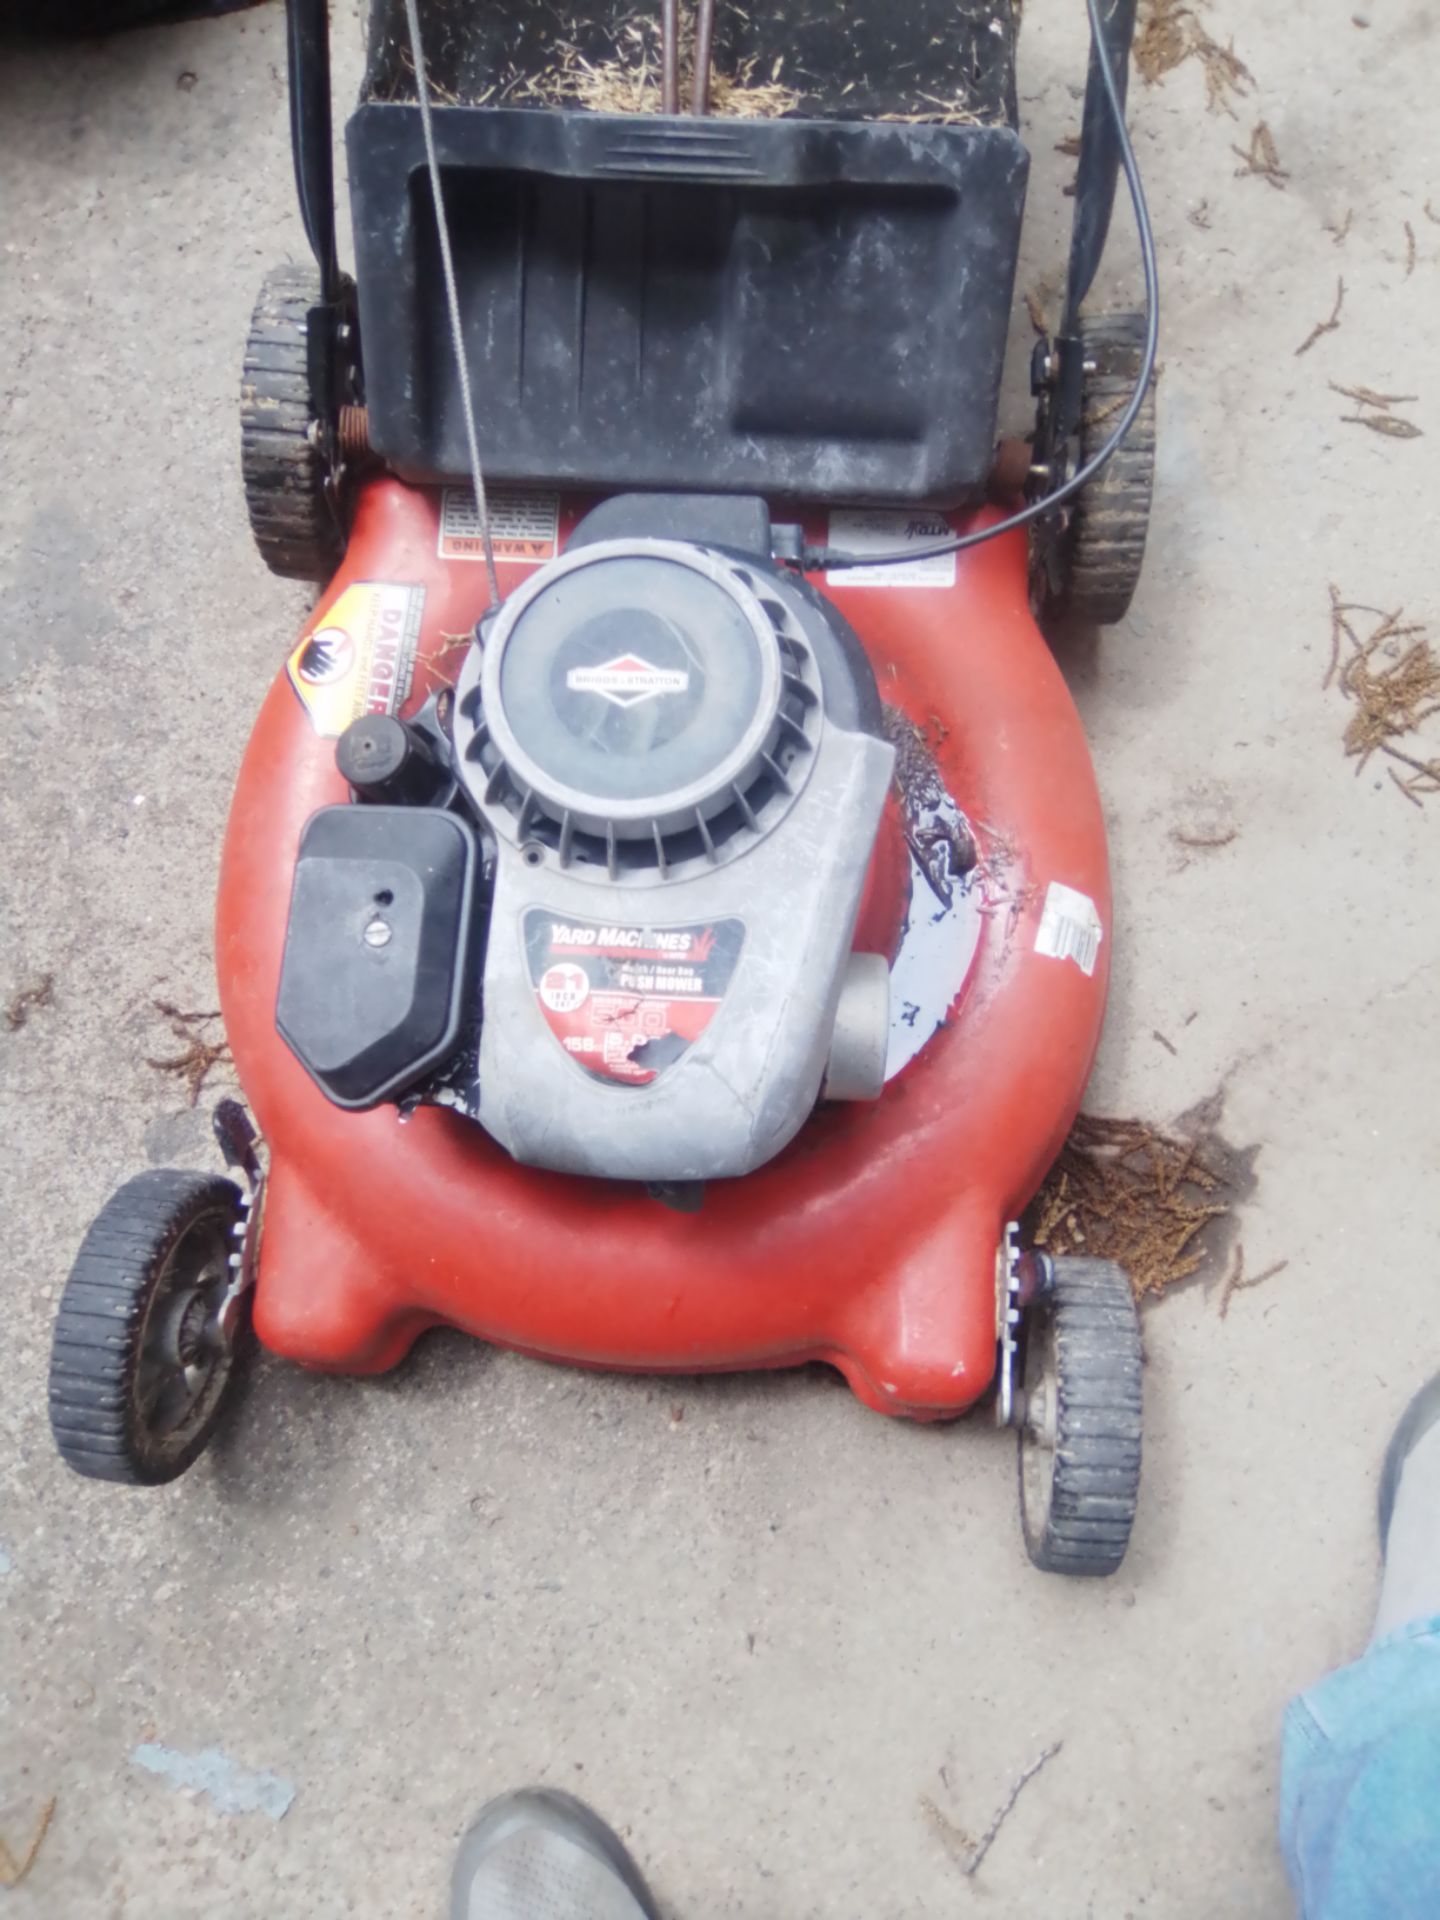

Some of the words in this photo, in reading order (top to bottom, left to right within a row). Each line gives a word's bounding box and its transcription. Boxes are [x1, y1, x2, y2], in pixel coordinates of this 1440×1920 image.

[452, 541, 526, 555] WARING
[366, 609, 402, 715] DANGER
[627, 675, 681, 686] STRATTON
[551, 925, 597, 946] YARD
[598, 927, 692, 950] MACNES
[545, 970, 584, 991] 21
[656, 975, 703, 992] MOWER
